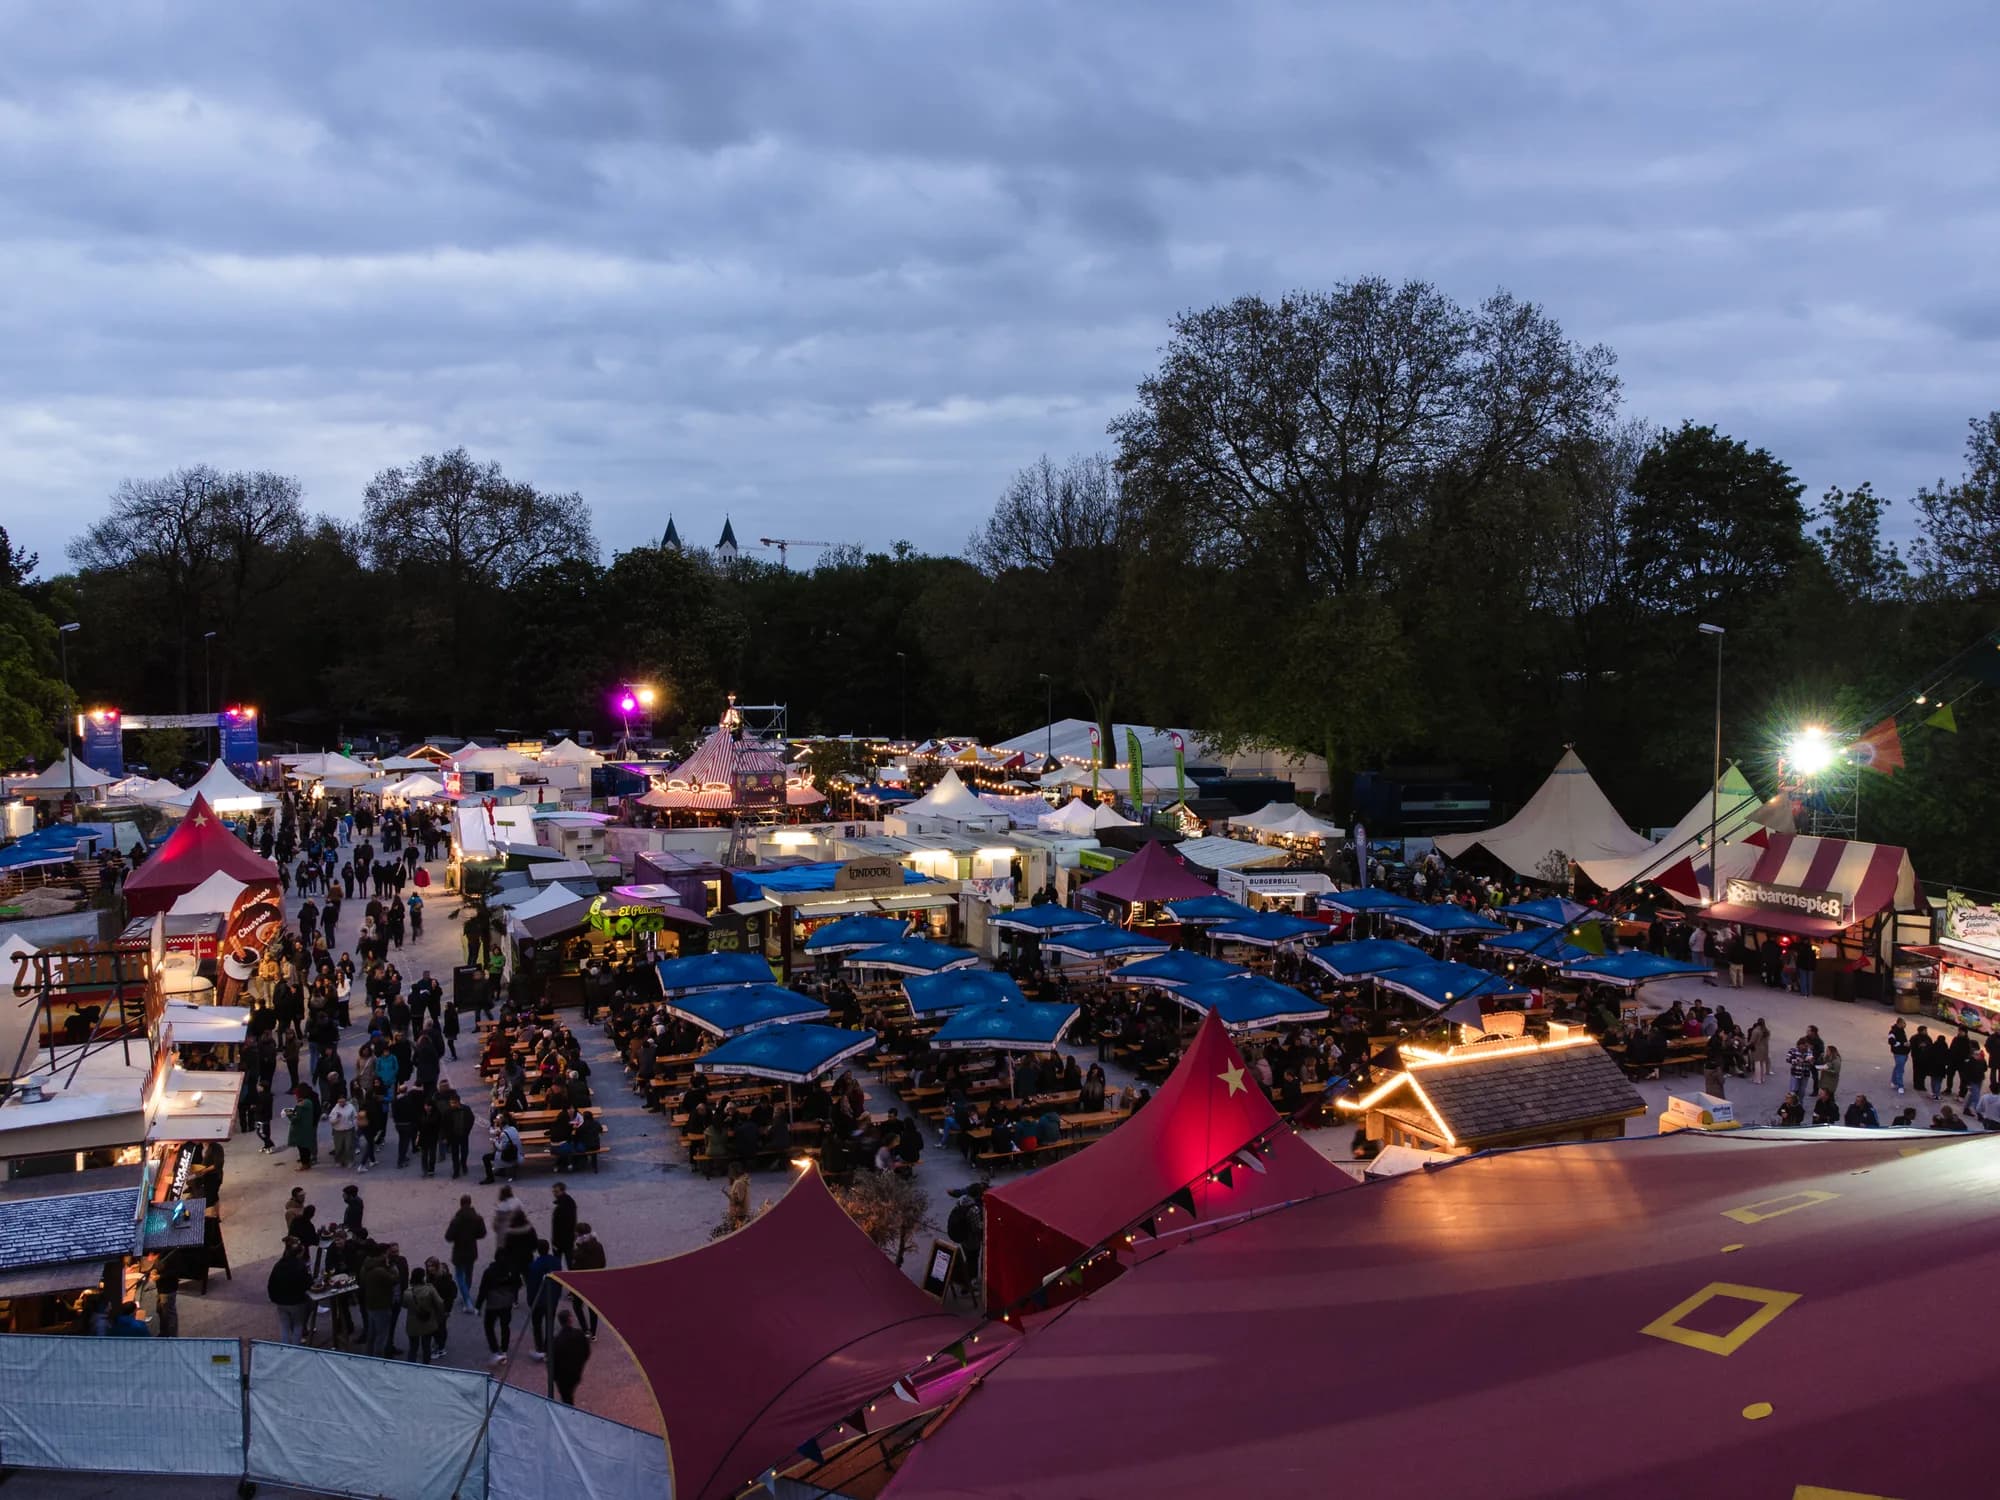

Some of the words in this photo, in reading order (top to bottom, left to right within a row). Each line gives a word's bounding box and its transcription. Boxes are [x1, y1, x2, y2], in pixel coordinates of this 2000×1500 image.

[241, 888, 271, 912] Churros
[238, 910, 271, 938] Churros
[603, 915, 665, 939] LOCO
